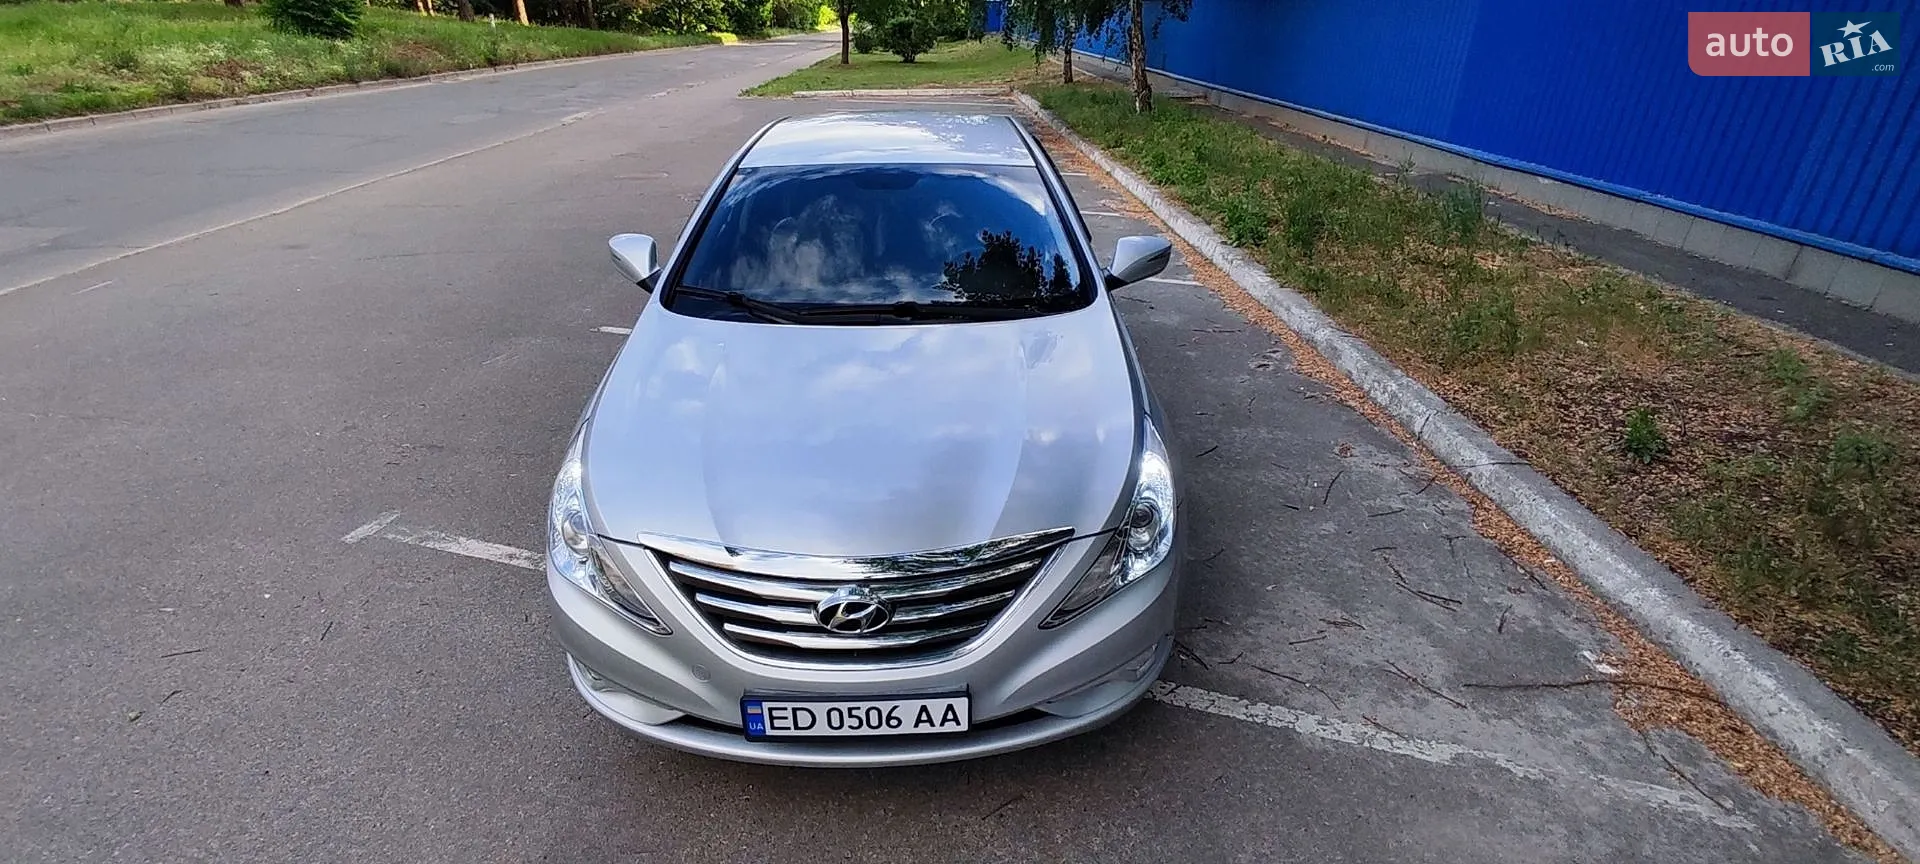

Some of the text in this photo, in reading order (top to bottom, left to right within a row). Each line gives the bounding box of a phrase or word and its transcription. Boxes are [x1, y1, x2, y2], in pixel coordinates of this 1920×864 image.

[767, 703, 962, 731] ED 0506 AA
[749, 722, 764, 731] UA
